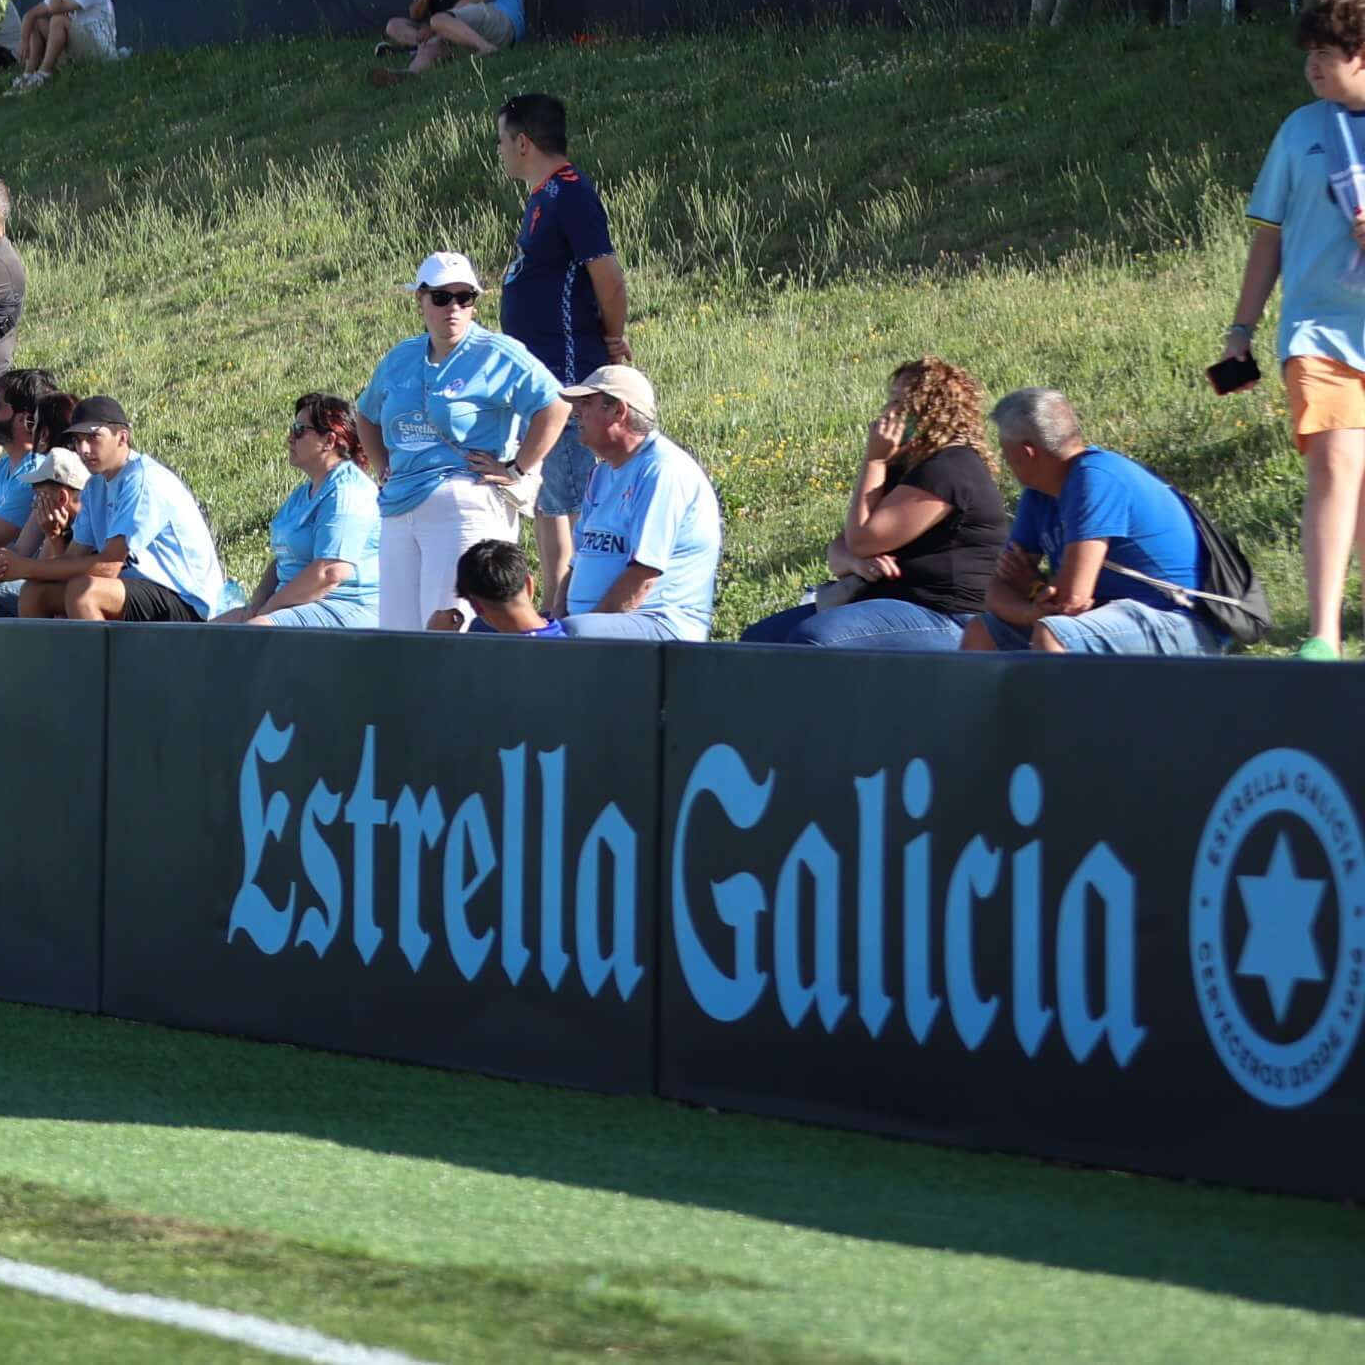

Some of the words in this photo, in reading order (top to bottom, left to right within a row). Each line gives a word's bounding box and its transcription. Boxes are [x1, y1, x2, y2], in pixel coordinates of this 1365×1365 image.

[581, 531, 625, 554] TROEN
[1207, 767, 1288, 867] ESTRELLA
[227, 710, 645, 1002] Estrella
[671, 742, 1149, 1069] Galicia
